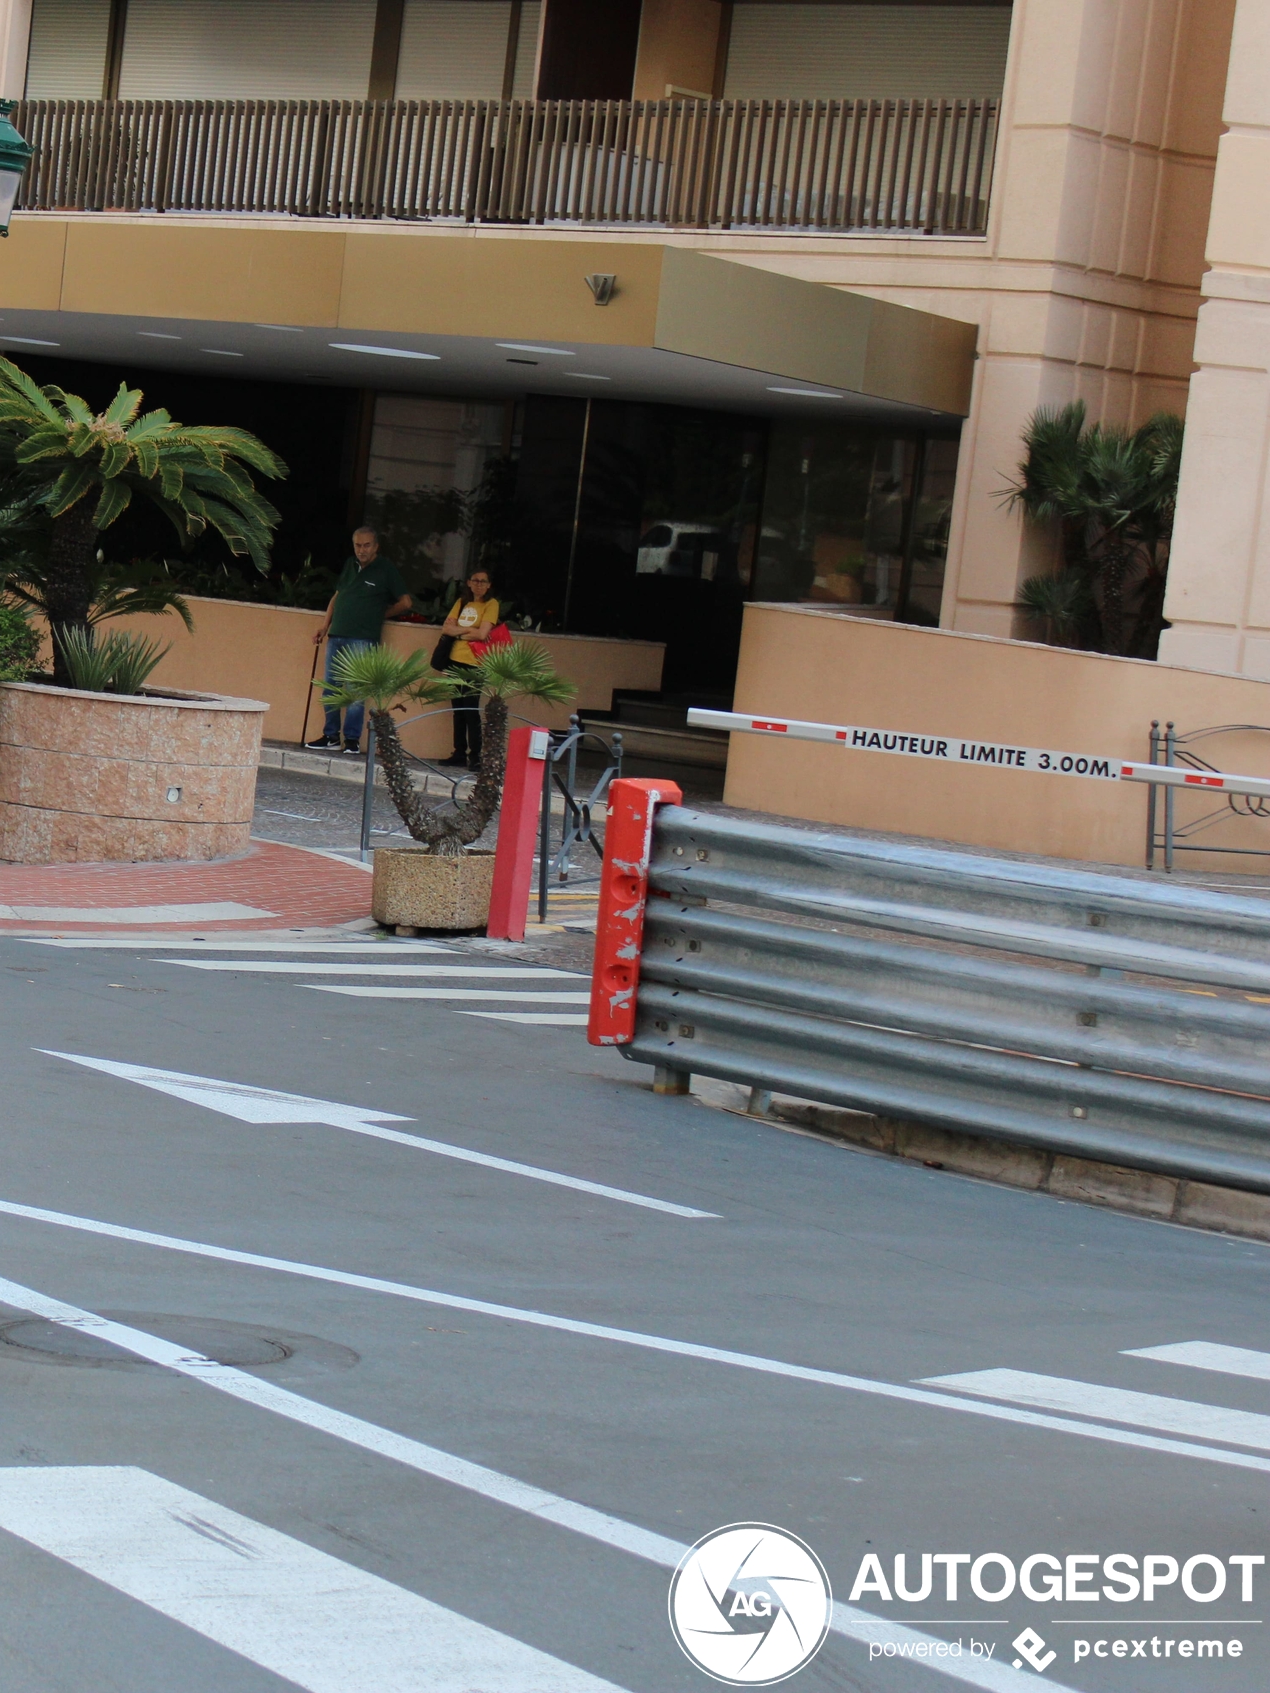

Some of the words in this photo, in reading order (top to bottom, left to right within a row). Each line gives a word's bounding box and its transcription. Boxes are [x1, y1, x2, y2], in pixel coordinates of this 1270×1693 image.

[851, 730, 947, 757] HAUTEUR
[959, 743, 1026, 767] LIMITE
[1038, 753, 1117, 778] 3.00M.
